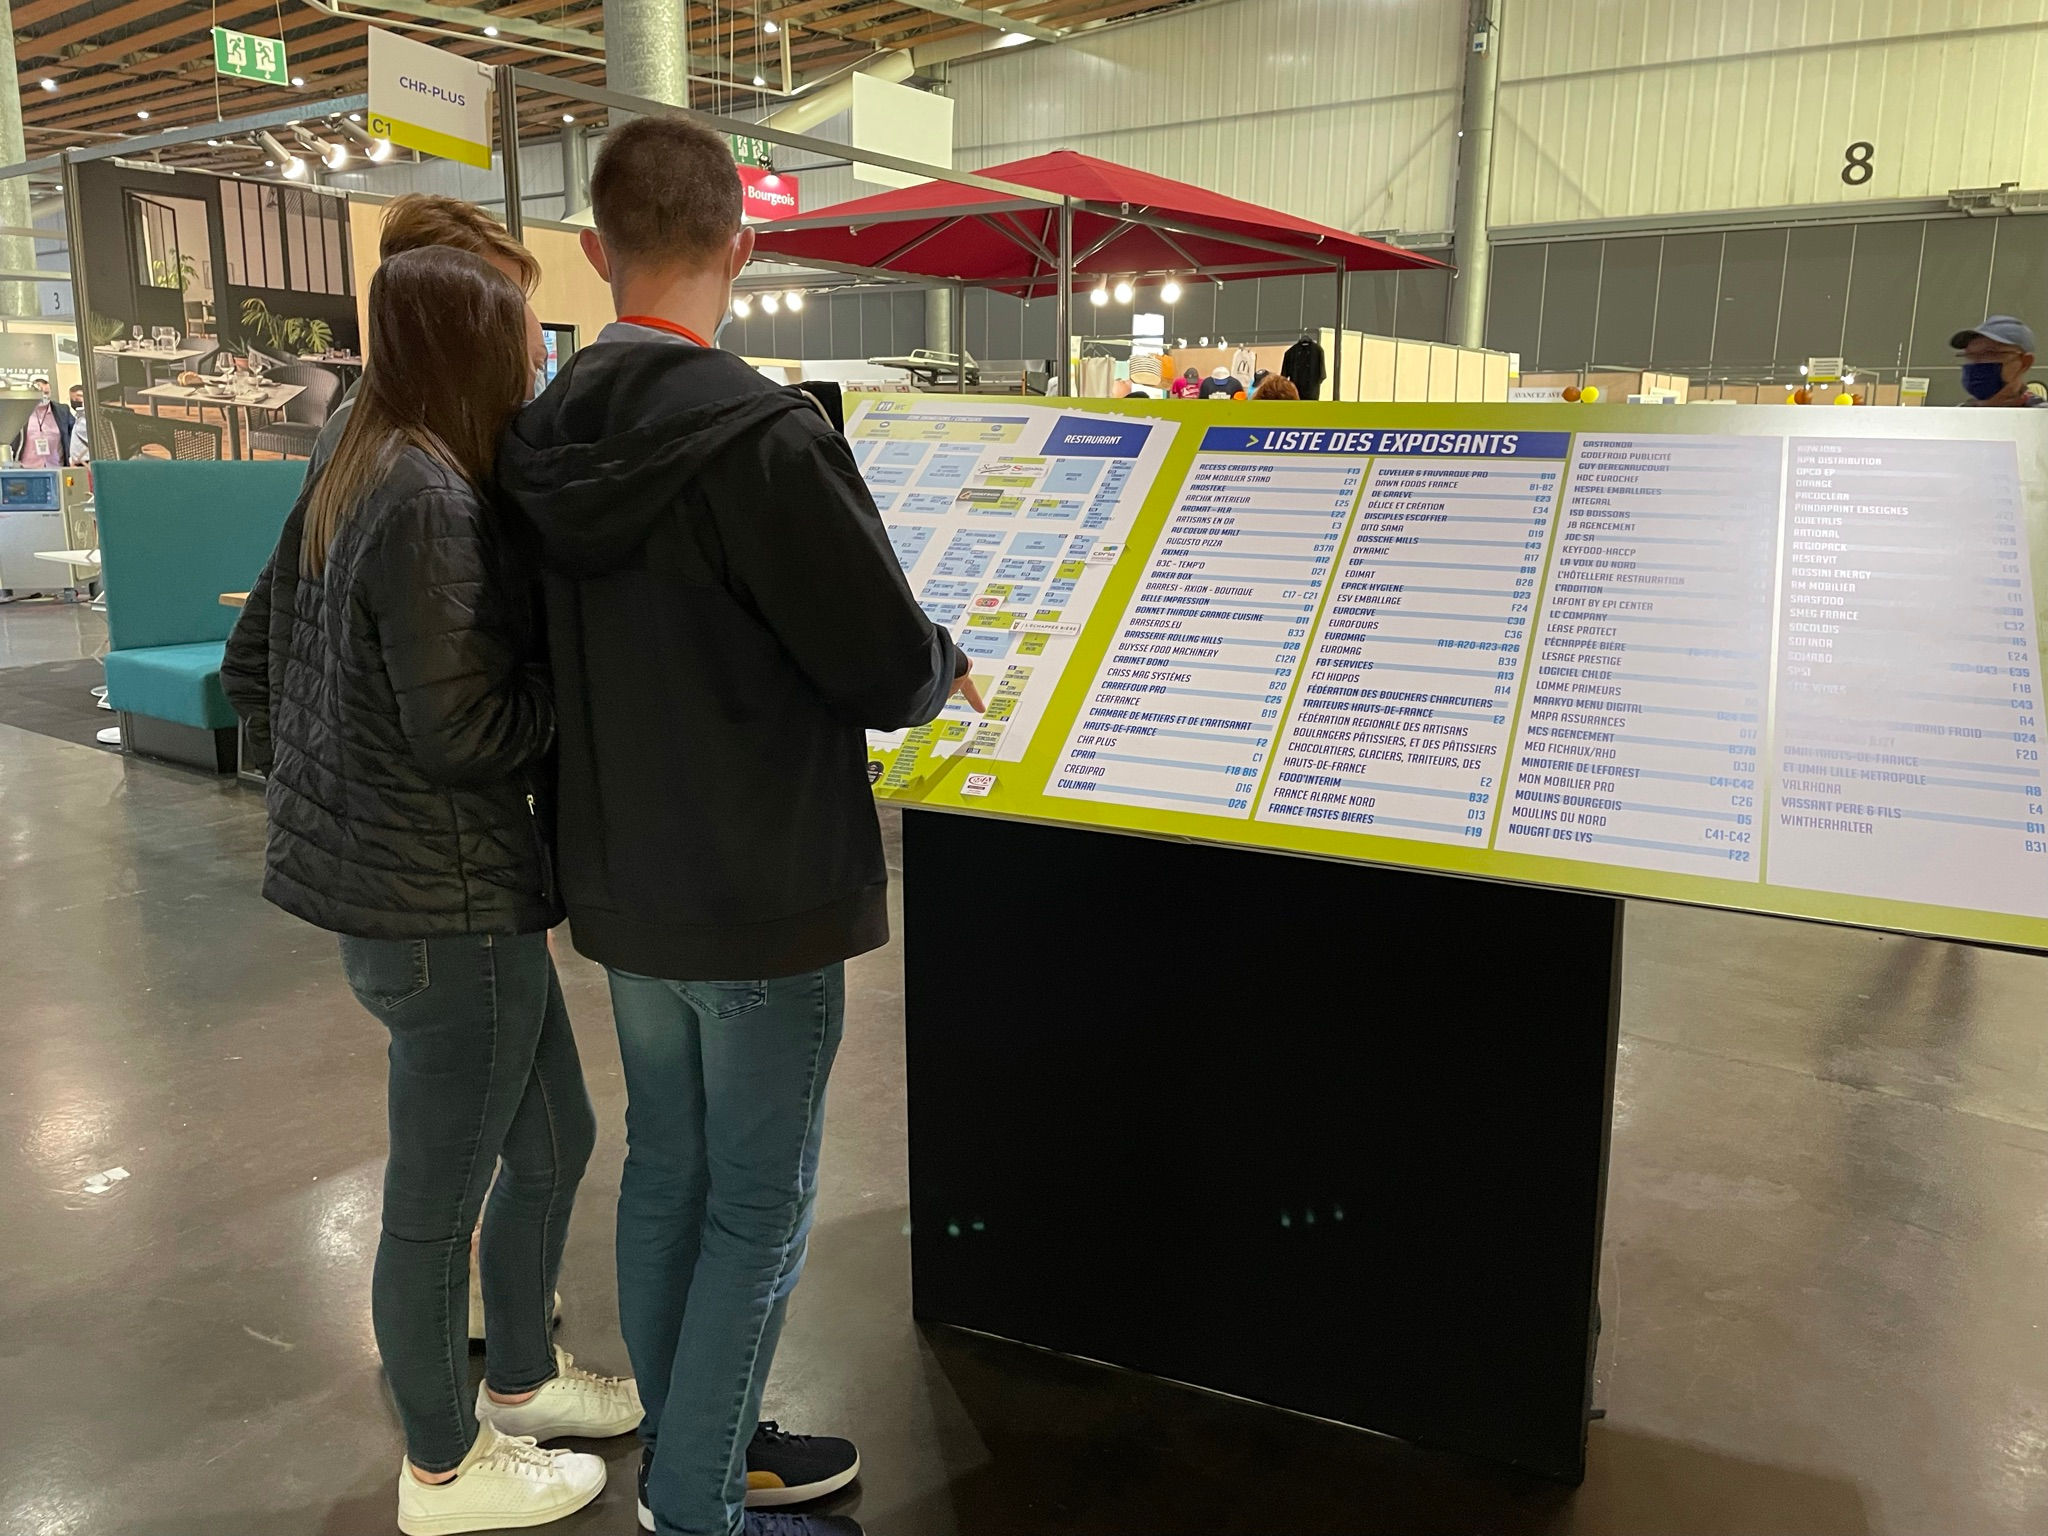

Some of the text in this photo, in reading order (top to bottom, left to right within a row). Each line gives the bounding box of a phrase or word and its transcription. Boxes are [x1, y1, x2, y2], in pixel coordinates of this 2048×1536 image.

[400, 76, 465, 106] CHR-PLUS
[372, 119, 391, 136] C1
[1841, 142, 1874, 185] 8
[748, 186, 794, 206] Bourgeois
[54, 292, 60, 310] 3
[1064, 435, 1122, 445] RESTAURANT
[1264, 431, 1518, 454] LISTE DES EXPOSANTS
[1368, 500, 1393, 509] DÉLICE
[1406, 502, 1444, 510] CRÉATION
[1572, 497, 1611, 506] INTEGRAL
[1405, 514, 1447, 522] ESCOFFIER
[1183, 527, 1207, 535] COEUR
[1357, 535, 1394, 543] DOSSCHE
[1341, 582, 1404, 592] EPACK HYGIENE
[1163, 596, 1210, 605] IMPRESSION
[1337, 594, 1528, 612] ESV EMBALLAGE F24
[1135, 606, 1264, 621] BONNET THIRODE GRANDE CUISINE
[1333, 607, 1376, 616] EUROCAVE
[1124, 630, 1167, 640] BRASSERIE
[1168, 634, 1199, 643] ROLLING
[1130, 618, 1304, 637] BRASEROS.EU B33
[1325, 632, 1366, 642] EUROMAG
[1329, 619, 1522, 639] EUROFOURS C36
[1547, 624, 1616, 636] LEASE PROTECT
[1119, 643, 1218, 657] BUYSSE FOOD MACHINERY
[1542, 652, 1622, 666] LESAGE PRESTIGE
[1113, 656, 1145, 665] CABINET
[1316, 658, 1373, 669] FBT SERVICES
[1101, 681, 1282, 704] CARREFOUR PRO C25
[1307, 685, 1493, 708] FÉDÉRATION DES BOUCHERS CHARCUTIERS
[1536, 681, 1621, 696] LOMME PRIMEURS
[1096, 694, 1277, 718] CERFRANCE B19
[1303, 699, 1505, 724] TRAITEURS HAUTS-DE-FRANCE E2
[1089, 708, 1252, 731] CHAMBRE DE METIERS ET DE L'ARTISANAT
[1531, 710, 1625, 728] MAPA ASSURANCES
[1083, 721, 1268, 747] HAUTS-DE-FRANCE F2
[1528, 726, 1614, 742] MCS AGENCEMENT
[1077, 735, 1262, 762] CHR PLUS C1
[1071, 750, 1257, 777] CPRIA F18 BIS
[1283, 757, 1492, 787] HAUTS-DE-FRANCE E2
[1521, 758, 1640, 779] MINOTERIE DE LEFOREST
[1064, 764, 1252, 793] CREDIPRO D16
[1058, 779, 1247, 809] CULINARI D26
[1519, 773, 1752, 807] MON MOBILIER PRO C26
[1783, 778, 2043, 815] VALRHONA E4
[1273, 788, 1485, 820] FRANCE ALARME NORD D13
[1515, 790, 1622, 811] MOULINS BOURGEOIS
[1269, 803, 1482, 837] FRANCE TASTES BIERES F19
[1781, 797, 2045, 834] VASSANT PERE & FILS B11
[1509, 823, 1749, 861] NOUGAT DES LYS F22
[1781, 814, 2046, 852] WINTHERHALTER B31
